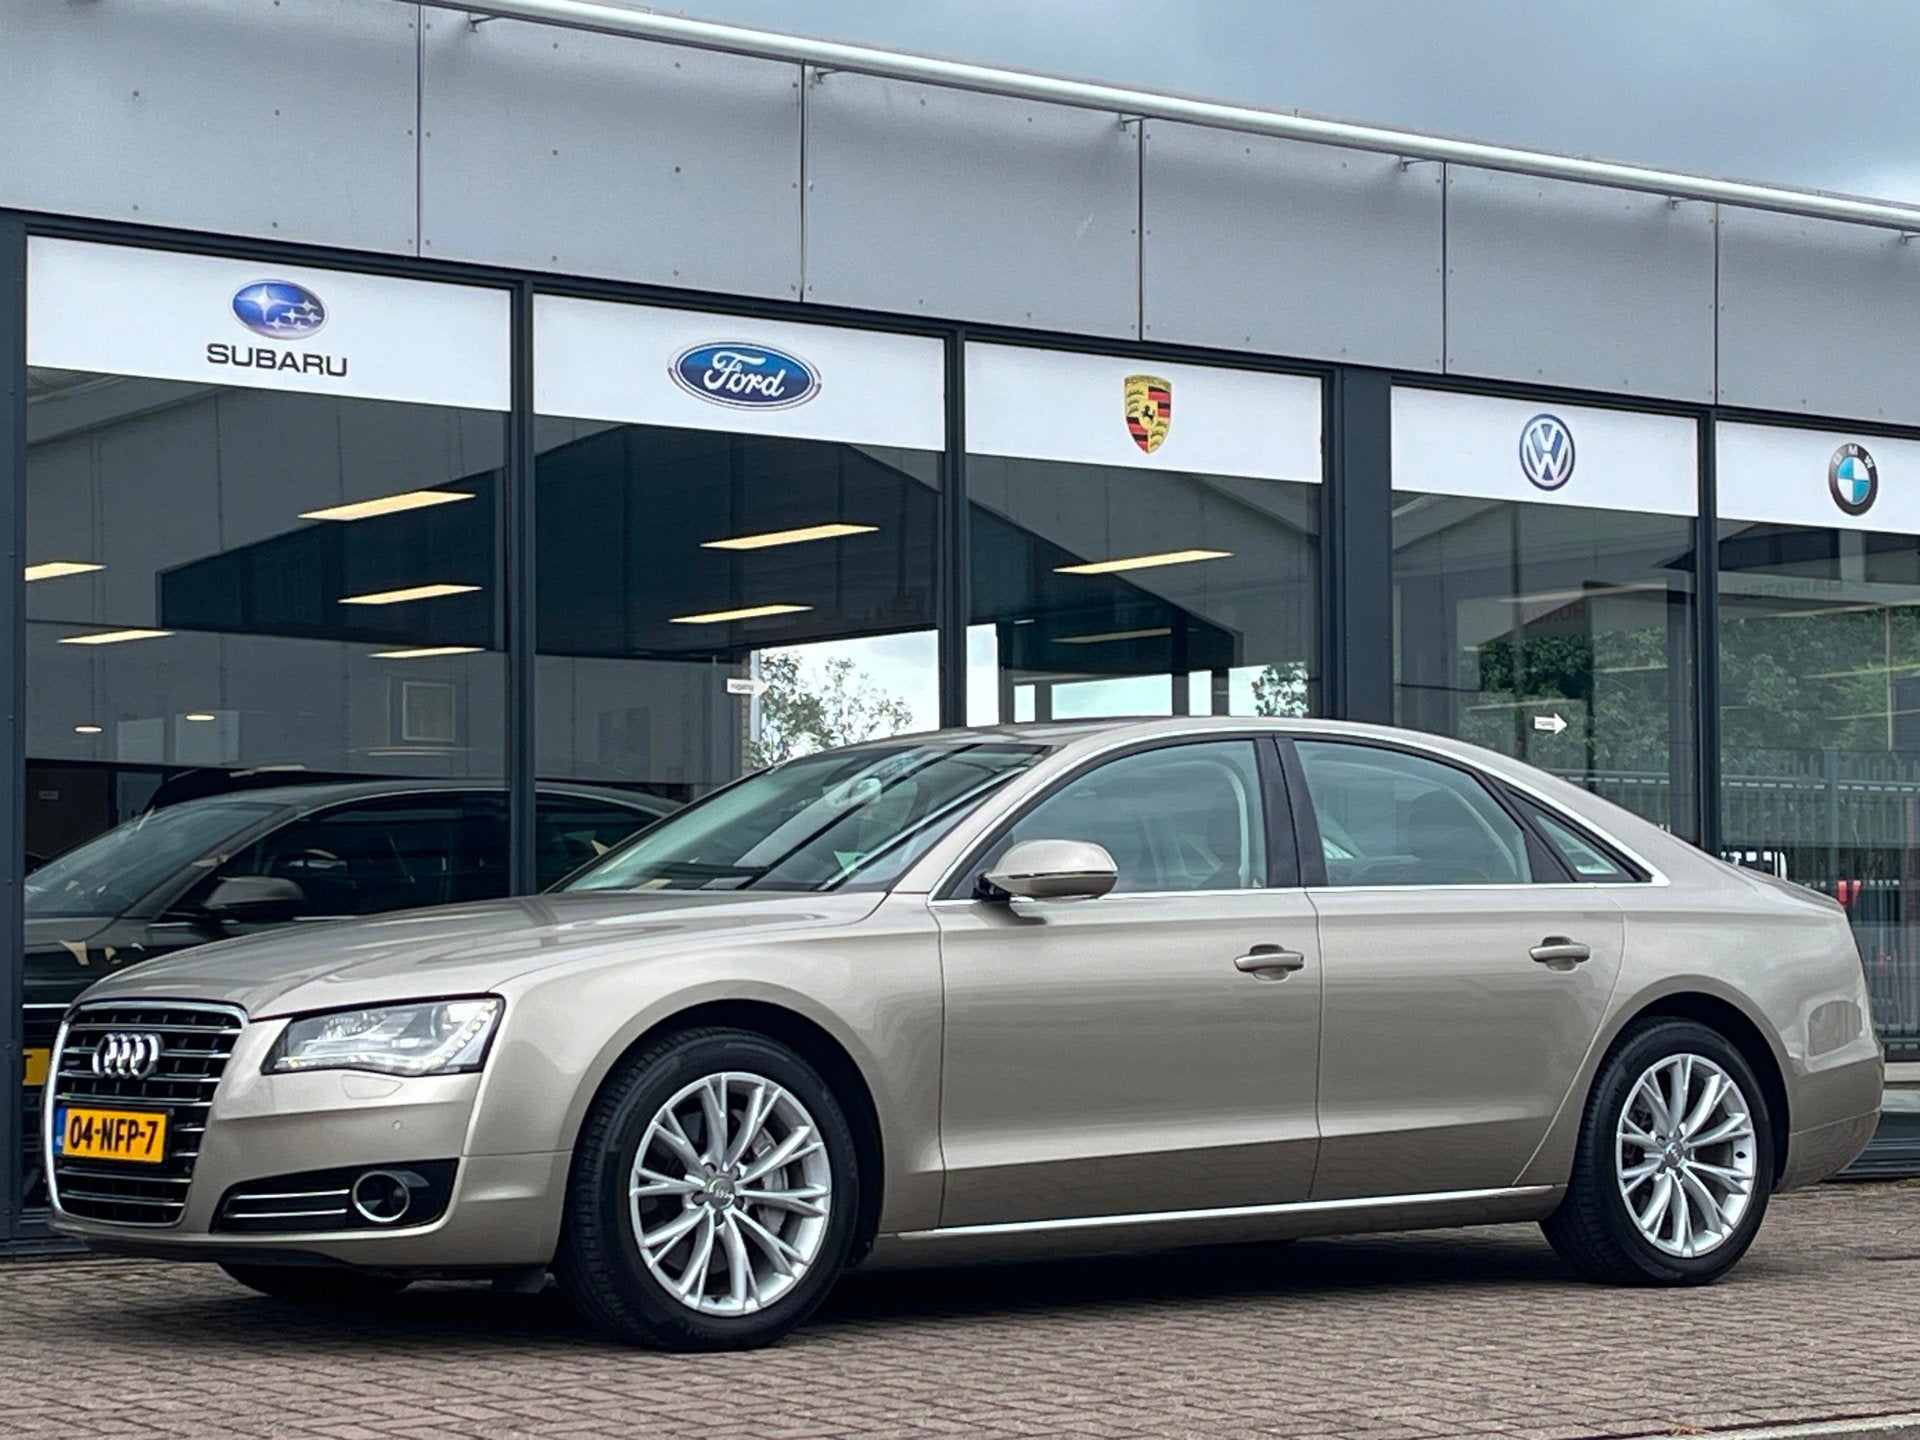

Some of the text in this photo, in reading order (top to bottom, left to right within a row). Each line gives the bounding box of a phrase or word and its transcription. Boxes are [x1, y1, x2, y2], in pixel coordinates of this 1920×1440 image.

[207, 343, 347, 377] SUBARU
[703, 350, 786, 398] Ford
[69, 1115, 159, 1154] 04-NFP-7
